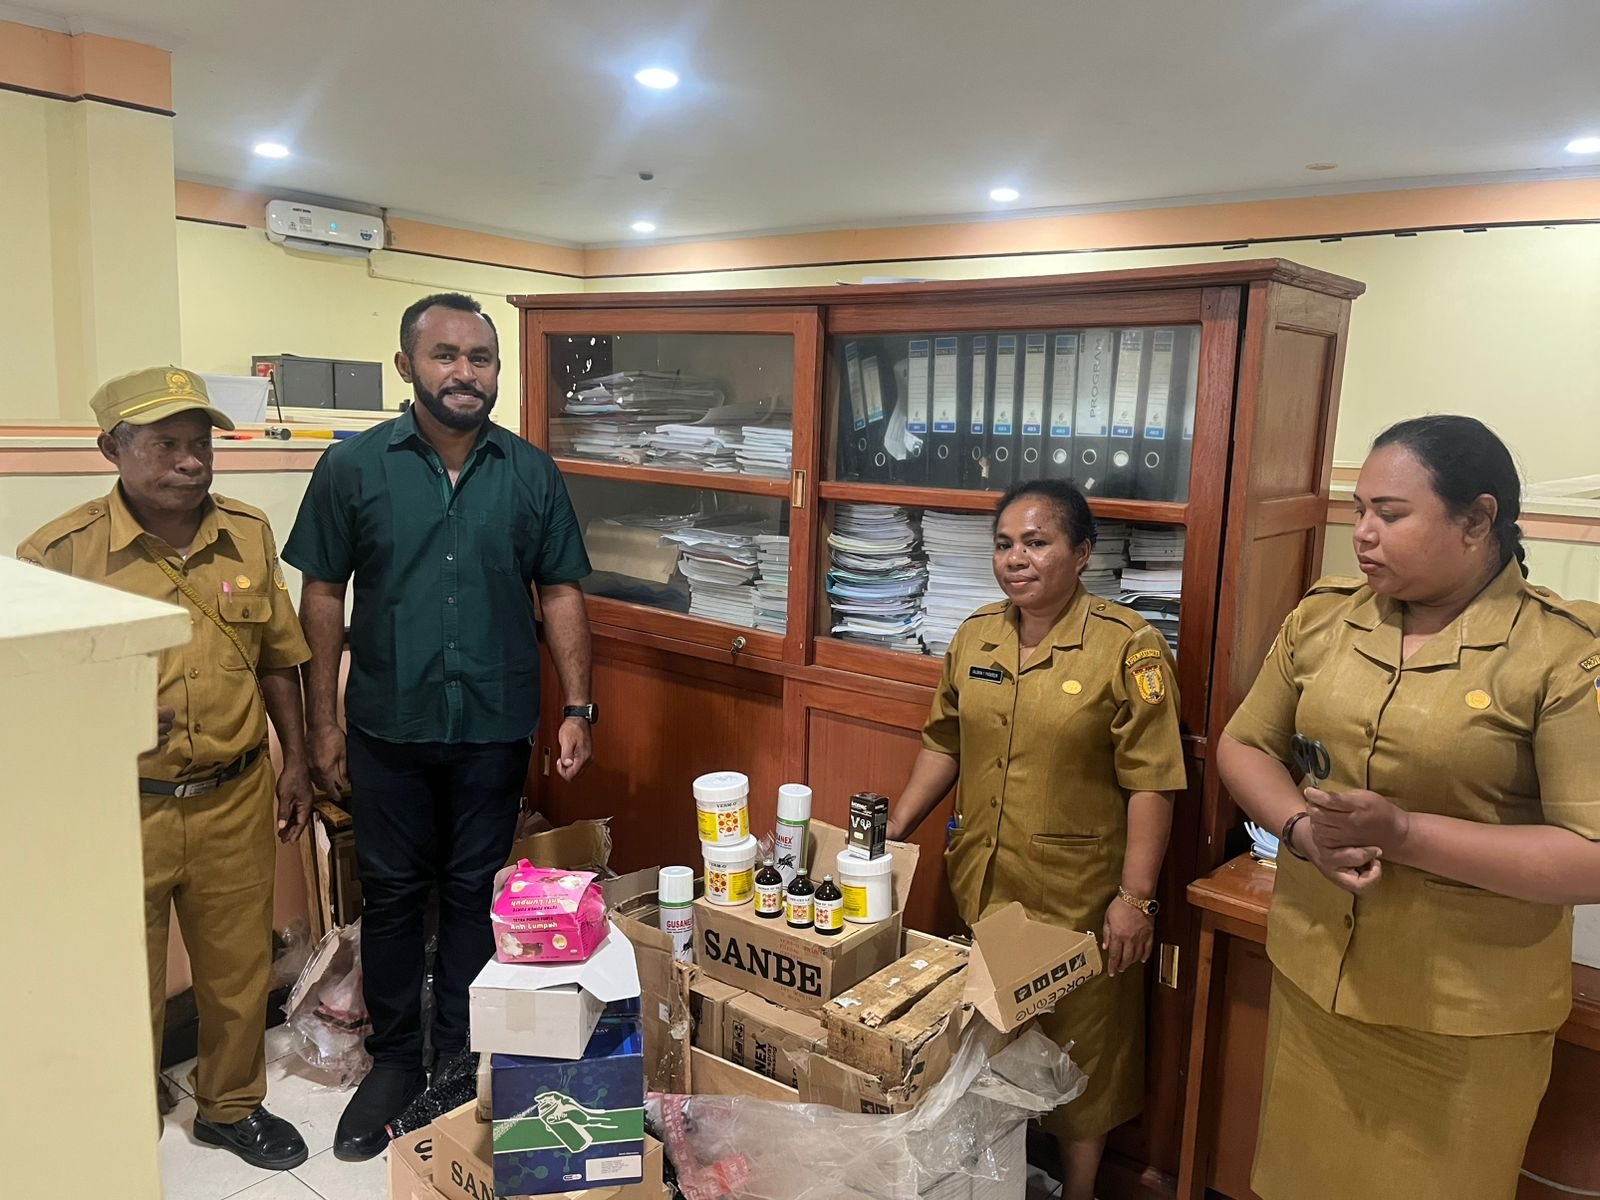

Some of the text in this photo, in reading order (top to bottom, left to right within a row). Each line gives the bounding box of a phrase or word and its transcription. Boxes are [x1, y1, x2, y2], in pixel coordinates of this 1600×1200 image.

[1089, 338, 1103, 418] PROGRAM
[704, 929, 822, 998] SANBE
[754, 1040, 767, 1073] NEX
[451, 1160, 507, 1200] SAN
